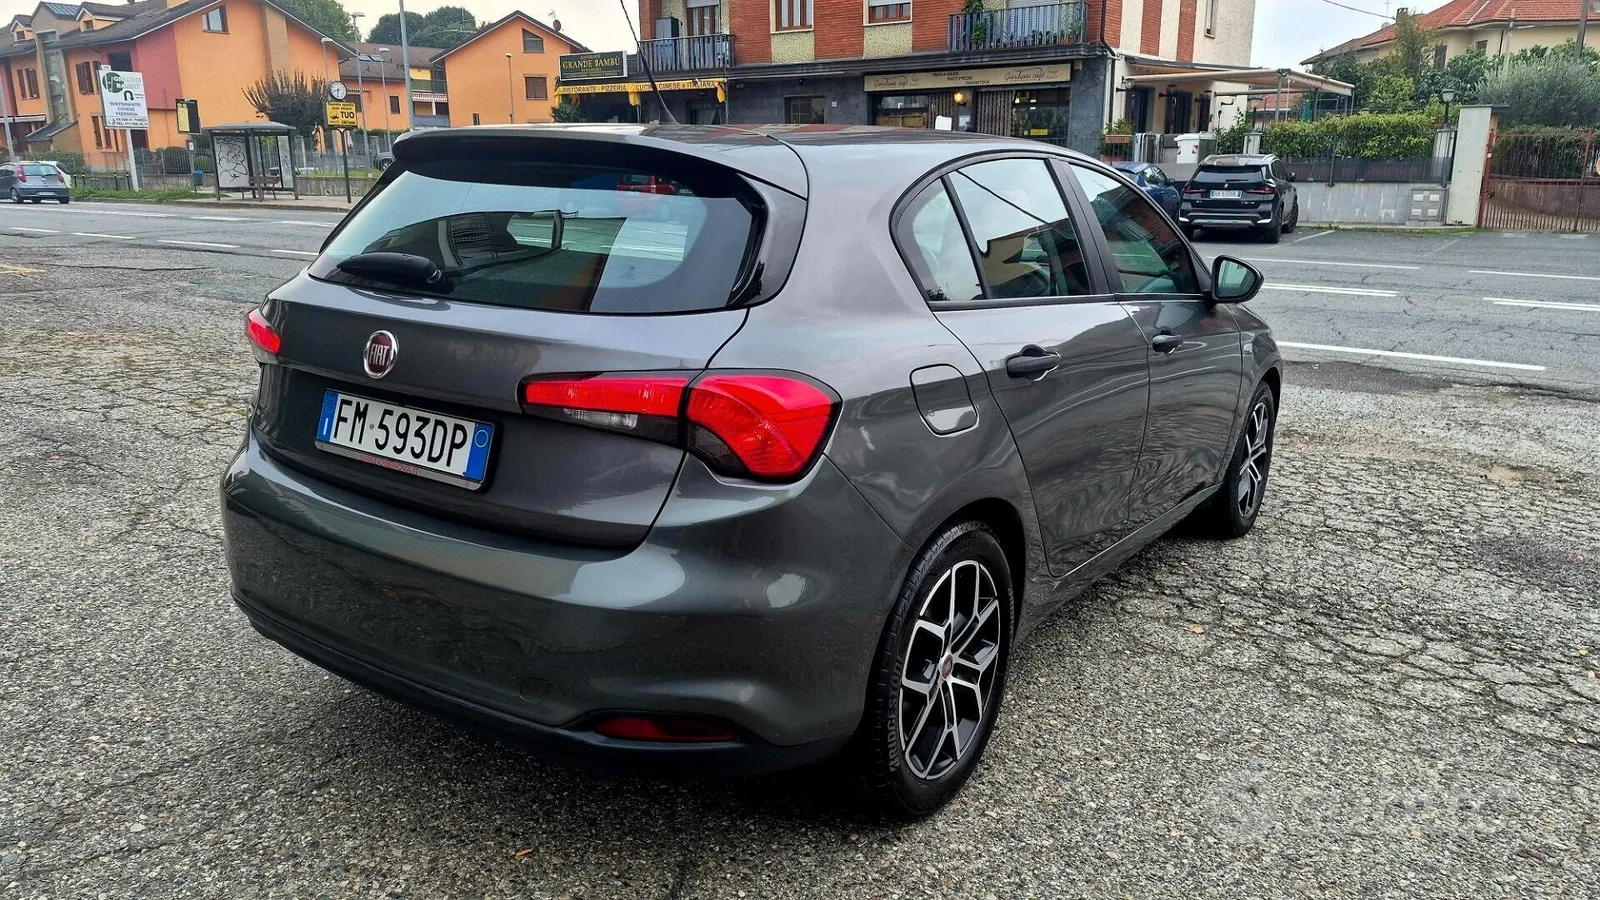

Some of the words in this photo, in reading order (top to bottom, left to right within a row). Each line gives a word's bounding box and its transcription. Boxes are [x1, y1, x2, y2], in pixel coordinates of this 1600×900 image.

[562, 59, 593, 69] GRANDE
[562, 85, 597, 94] RISTORANTE
[601, 83, 627, 92] PIZZERIA
[658, 82, 681, 90] CINESE
[369, 344, 390, 366] FIAT
[887, 650, 905, 773] BRIDGESTONE
